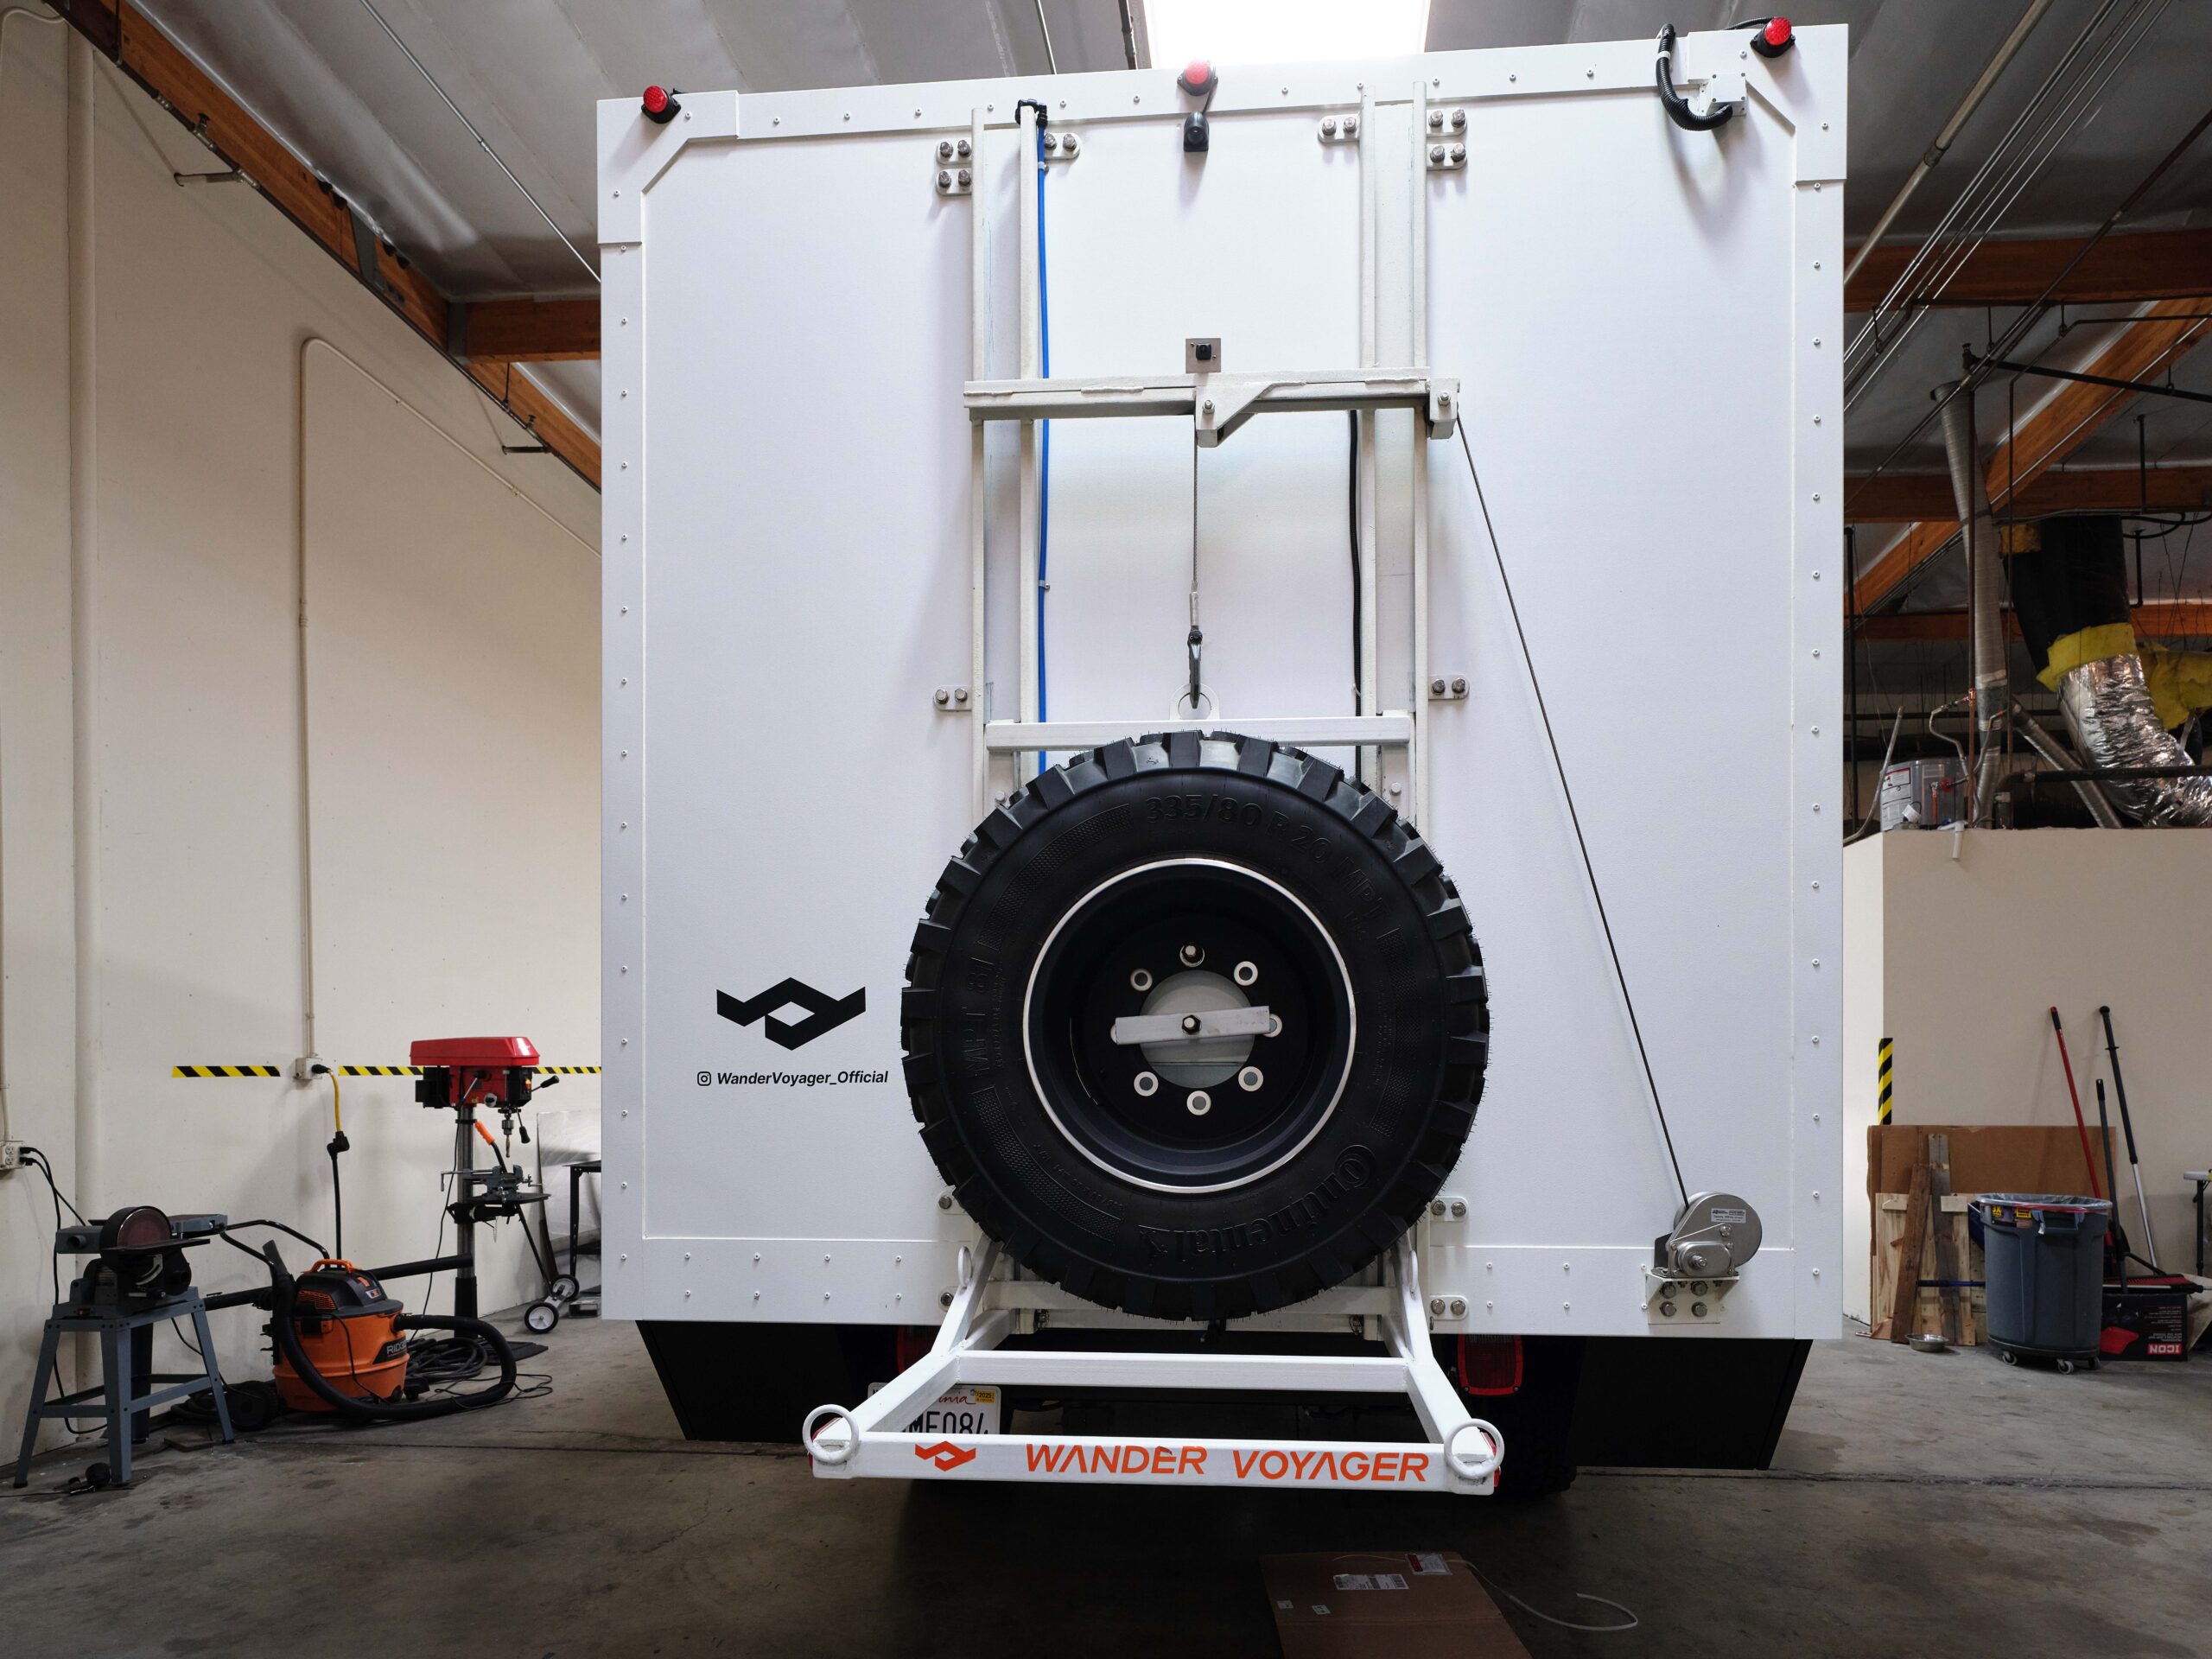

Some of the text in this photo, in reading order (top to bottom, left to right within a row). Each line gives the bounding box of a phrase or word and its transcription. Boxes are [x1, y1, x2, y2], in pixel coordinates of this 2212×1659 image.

[1145, 792, 1263, 828] 335/80
[1291, 824, 1333, 864] 20
[717, 1070, 889, 1087] WanderVoyager_Official
[1173, 1143, 1376, 1263] Continental
[2149, 1344, 2180, 1354] ICON
[1026, 1444, 1429, 1482] WANDER VOYAGER
